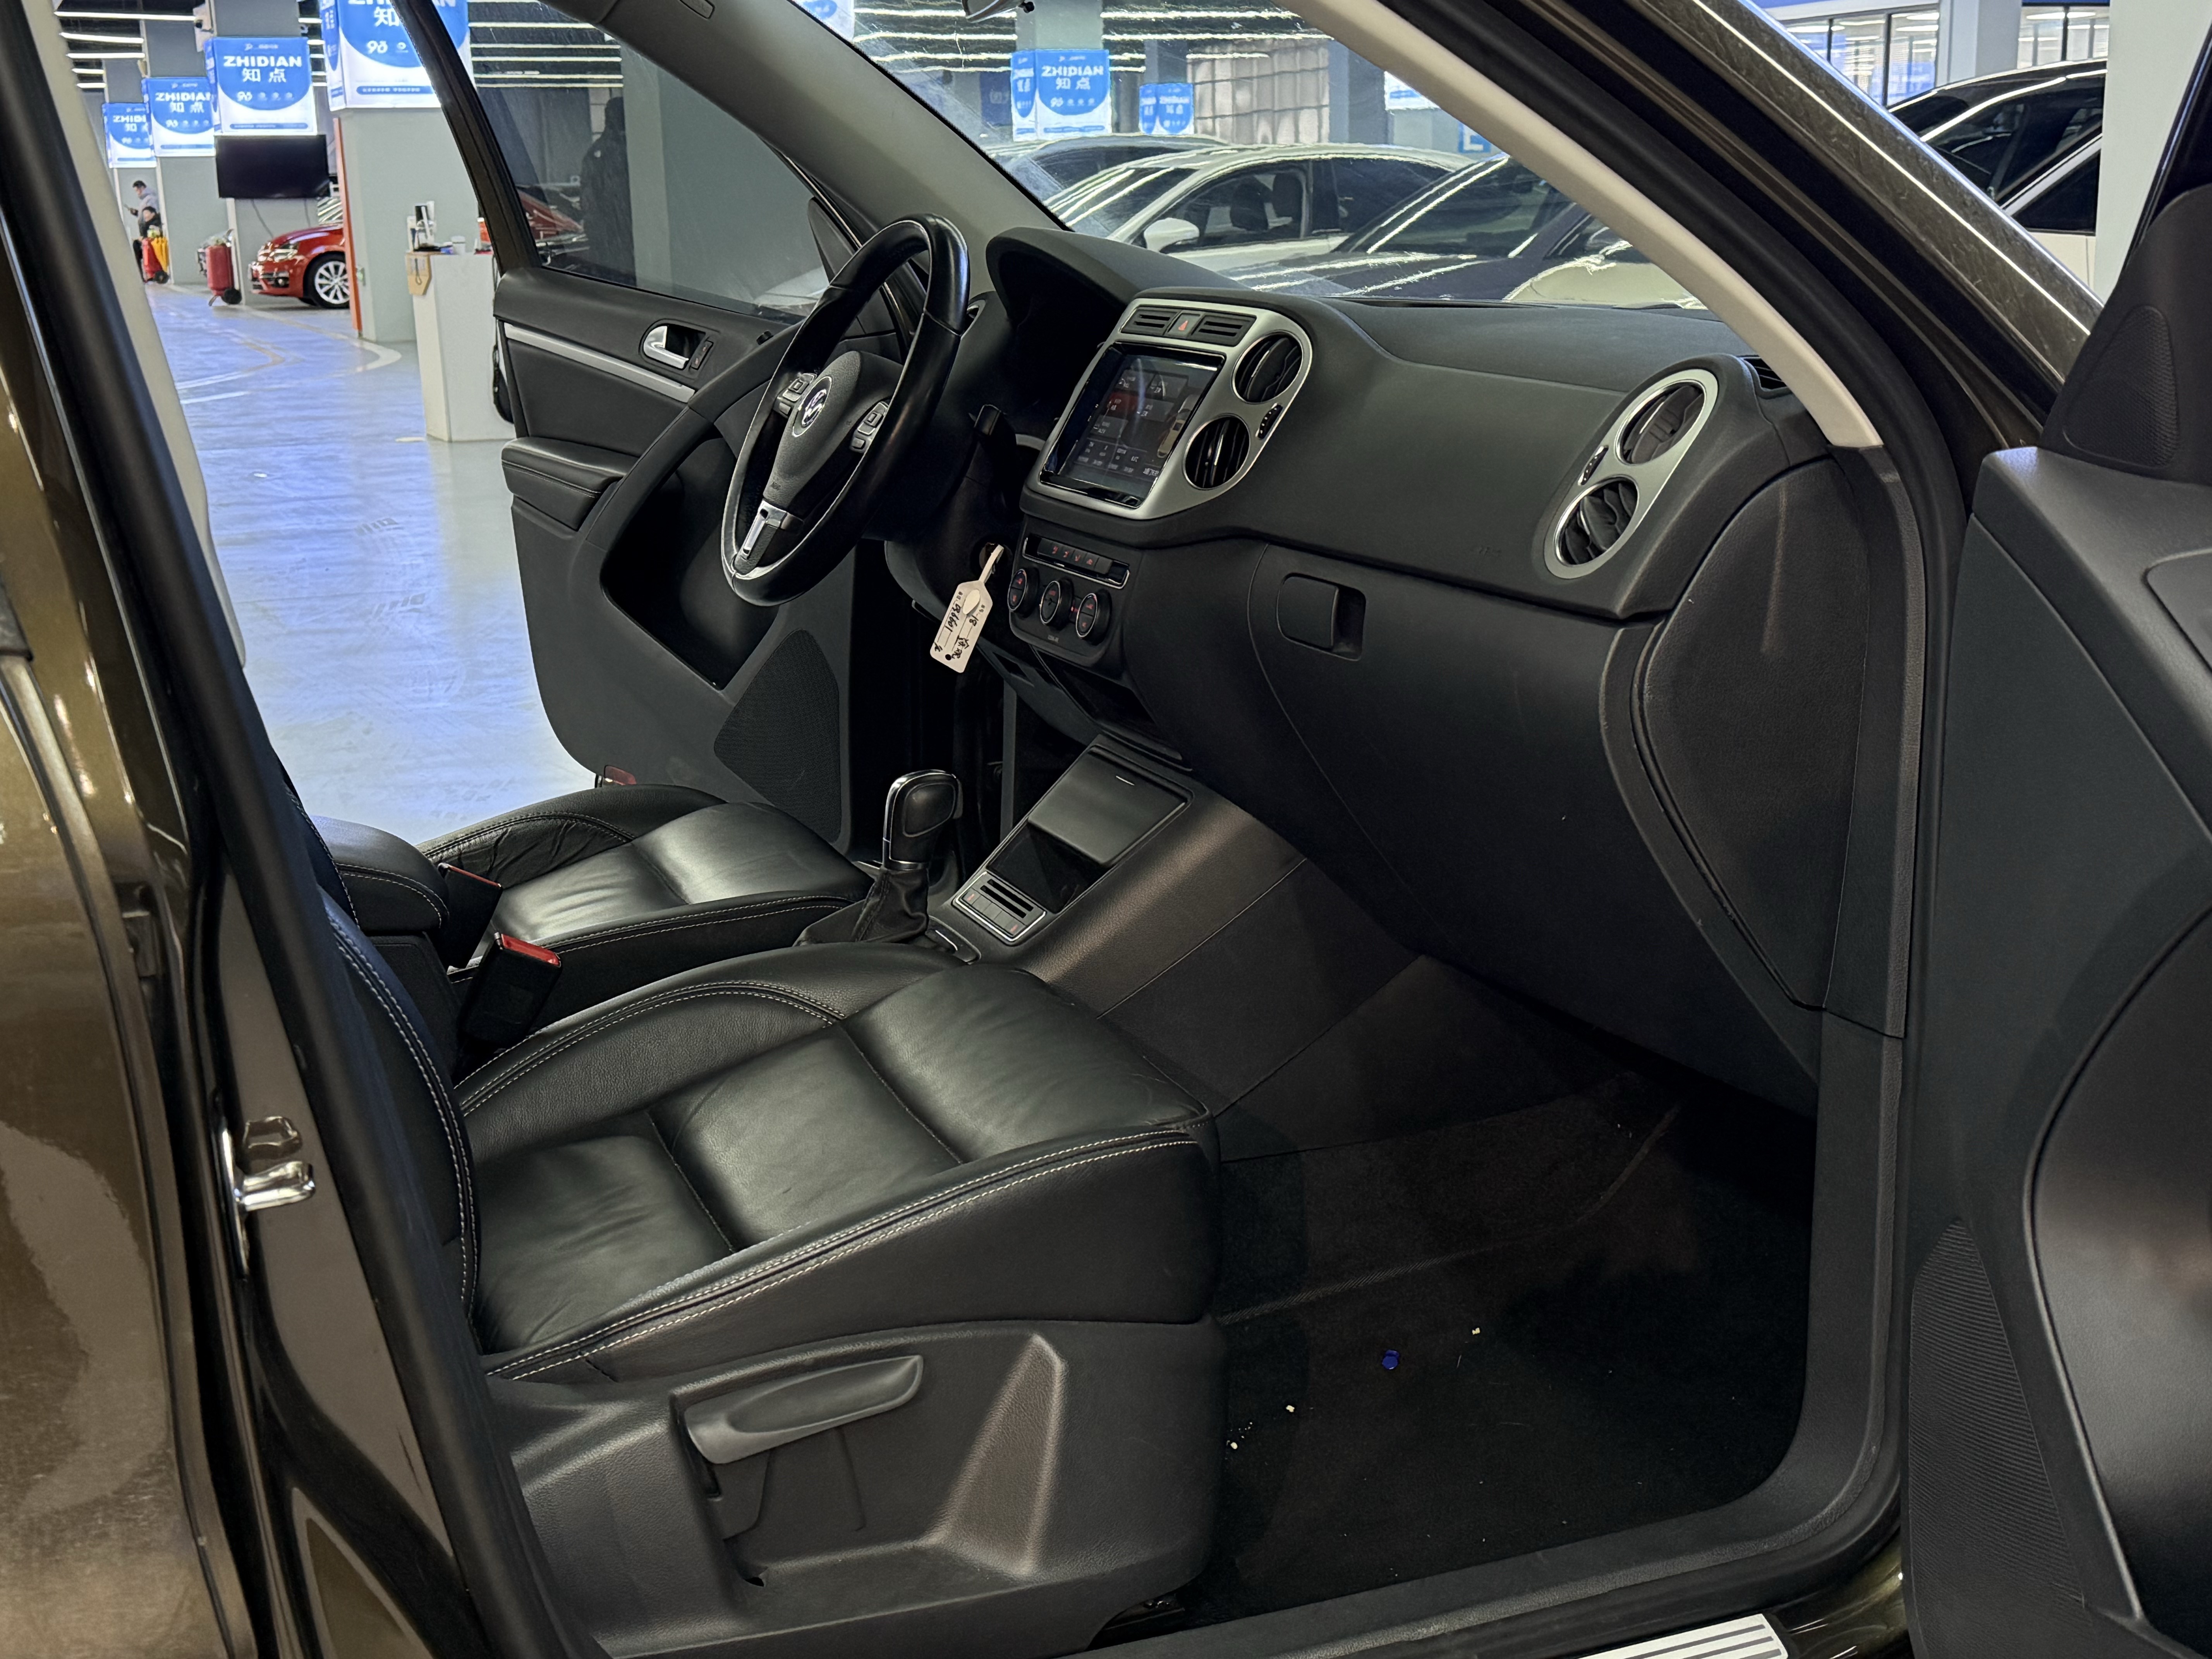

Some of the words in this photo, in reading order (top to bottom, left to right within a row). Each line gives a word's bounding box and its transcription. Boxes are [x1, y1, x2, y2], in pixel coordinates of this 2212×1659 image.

[223, 56, 302, 67] ZHIDIAN
[242, 67, 287, 82] 知点
[1041, 65, 1104, 77] ZHIDIAN
